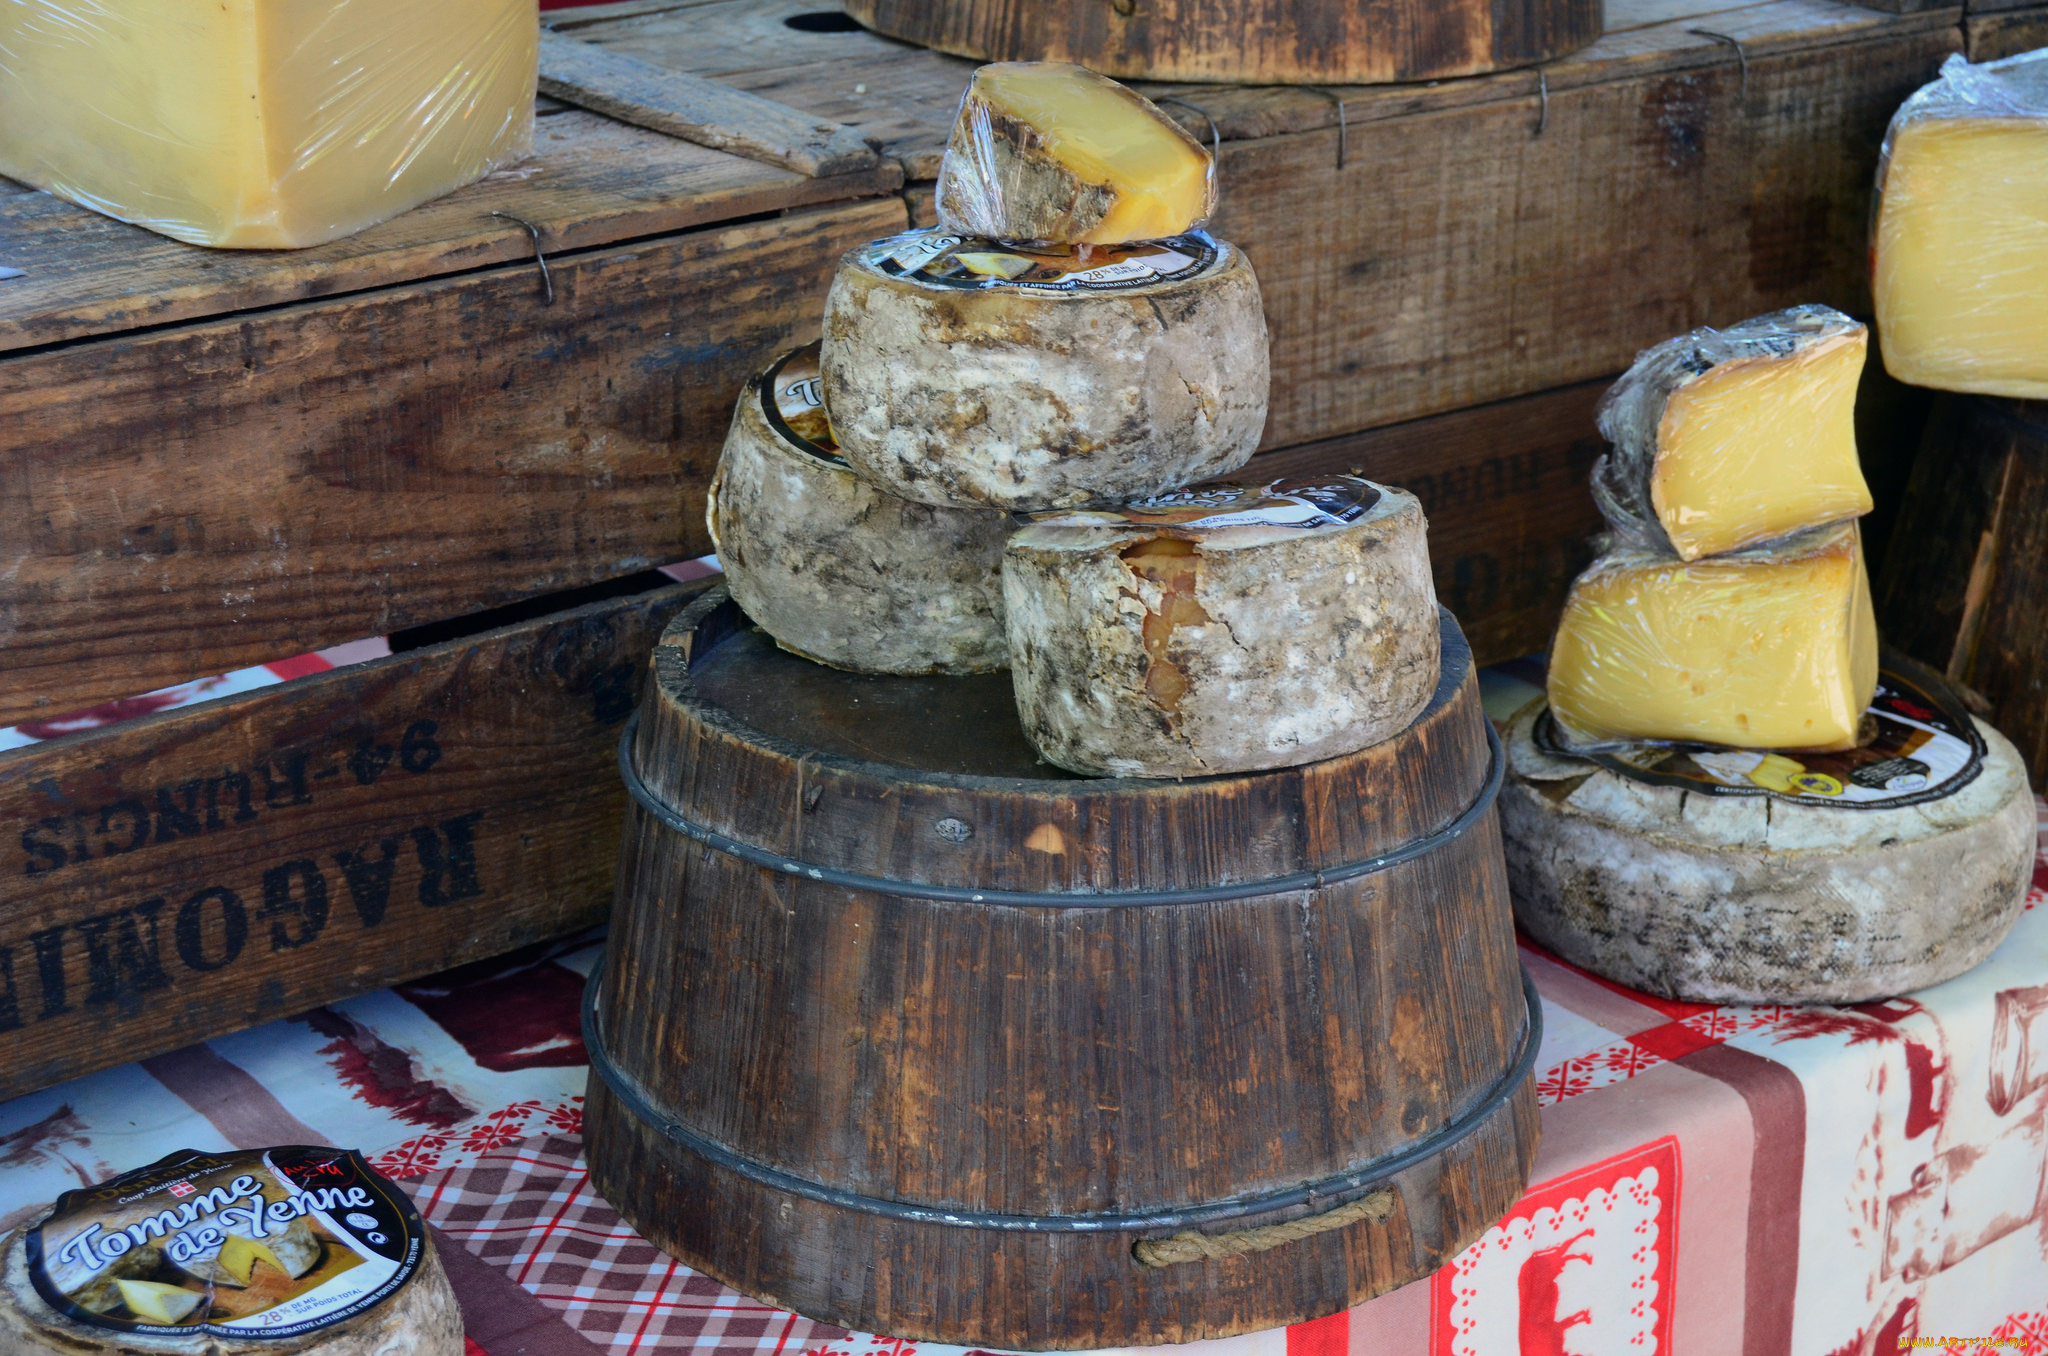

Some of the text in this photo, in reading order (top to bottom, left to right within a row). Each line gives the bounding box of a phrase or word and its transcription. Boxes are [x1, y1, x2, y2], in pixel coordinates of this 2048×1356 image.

[118, 1192, 145, 1204] Coop
[188, 1172, 201, 1180] de
[60, 1175, 263, 1270] Tomme
[171, 1187, 375, 1261] de Yenne
[182, 1326, 192, 1334] ET
[229, 1327, 246, 1336] PAR
[247, 1328, 260, 1336] LA
[260, 1321, 314, 1336] COOPÉRATIVE
[315, 1311, 348, 1327] LAITIÈRE
[357, 1296, 380, 1311] YENNE
[291, 1302, 304, 1310] DE
[305, 1297, 317, 1307] MG
[295, 1288, 364, 1315] SUR POIDS TOTAL
